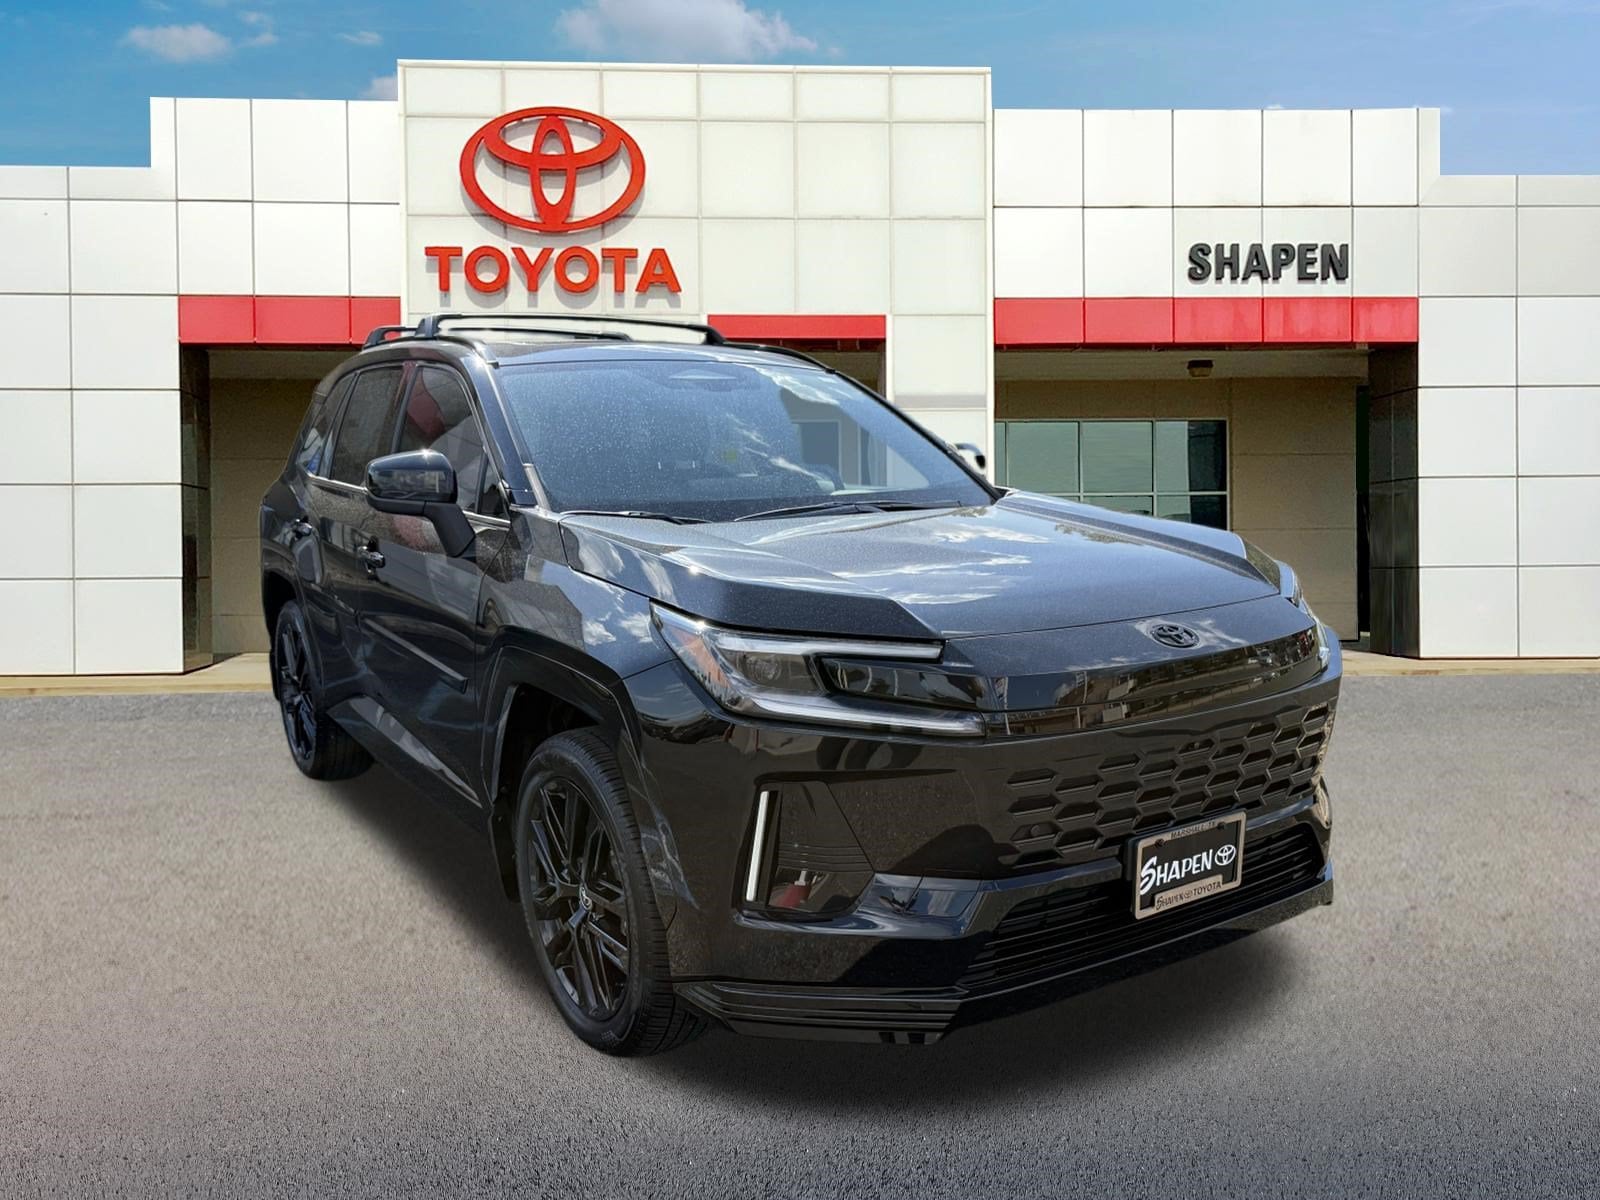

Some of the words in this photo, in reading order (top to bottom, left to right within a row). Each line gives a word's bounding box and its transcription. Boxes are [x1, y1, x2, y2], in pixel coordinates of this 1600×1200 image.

[425, 245, 682, 293] TOYOTA
[1188, 243, 1349, 281] SHAPEN
[1140, 849, 1213, 895] SHAPEN
[1155, 894, 1184, 911] SHAPEN
[1193, 881, 1222, 896] TOYOTA
